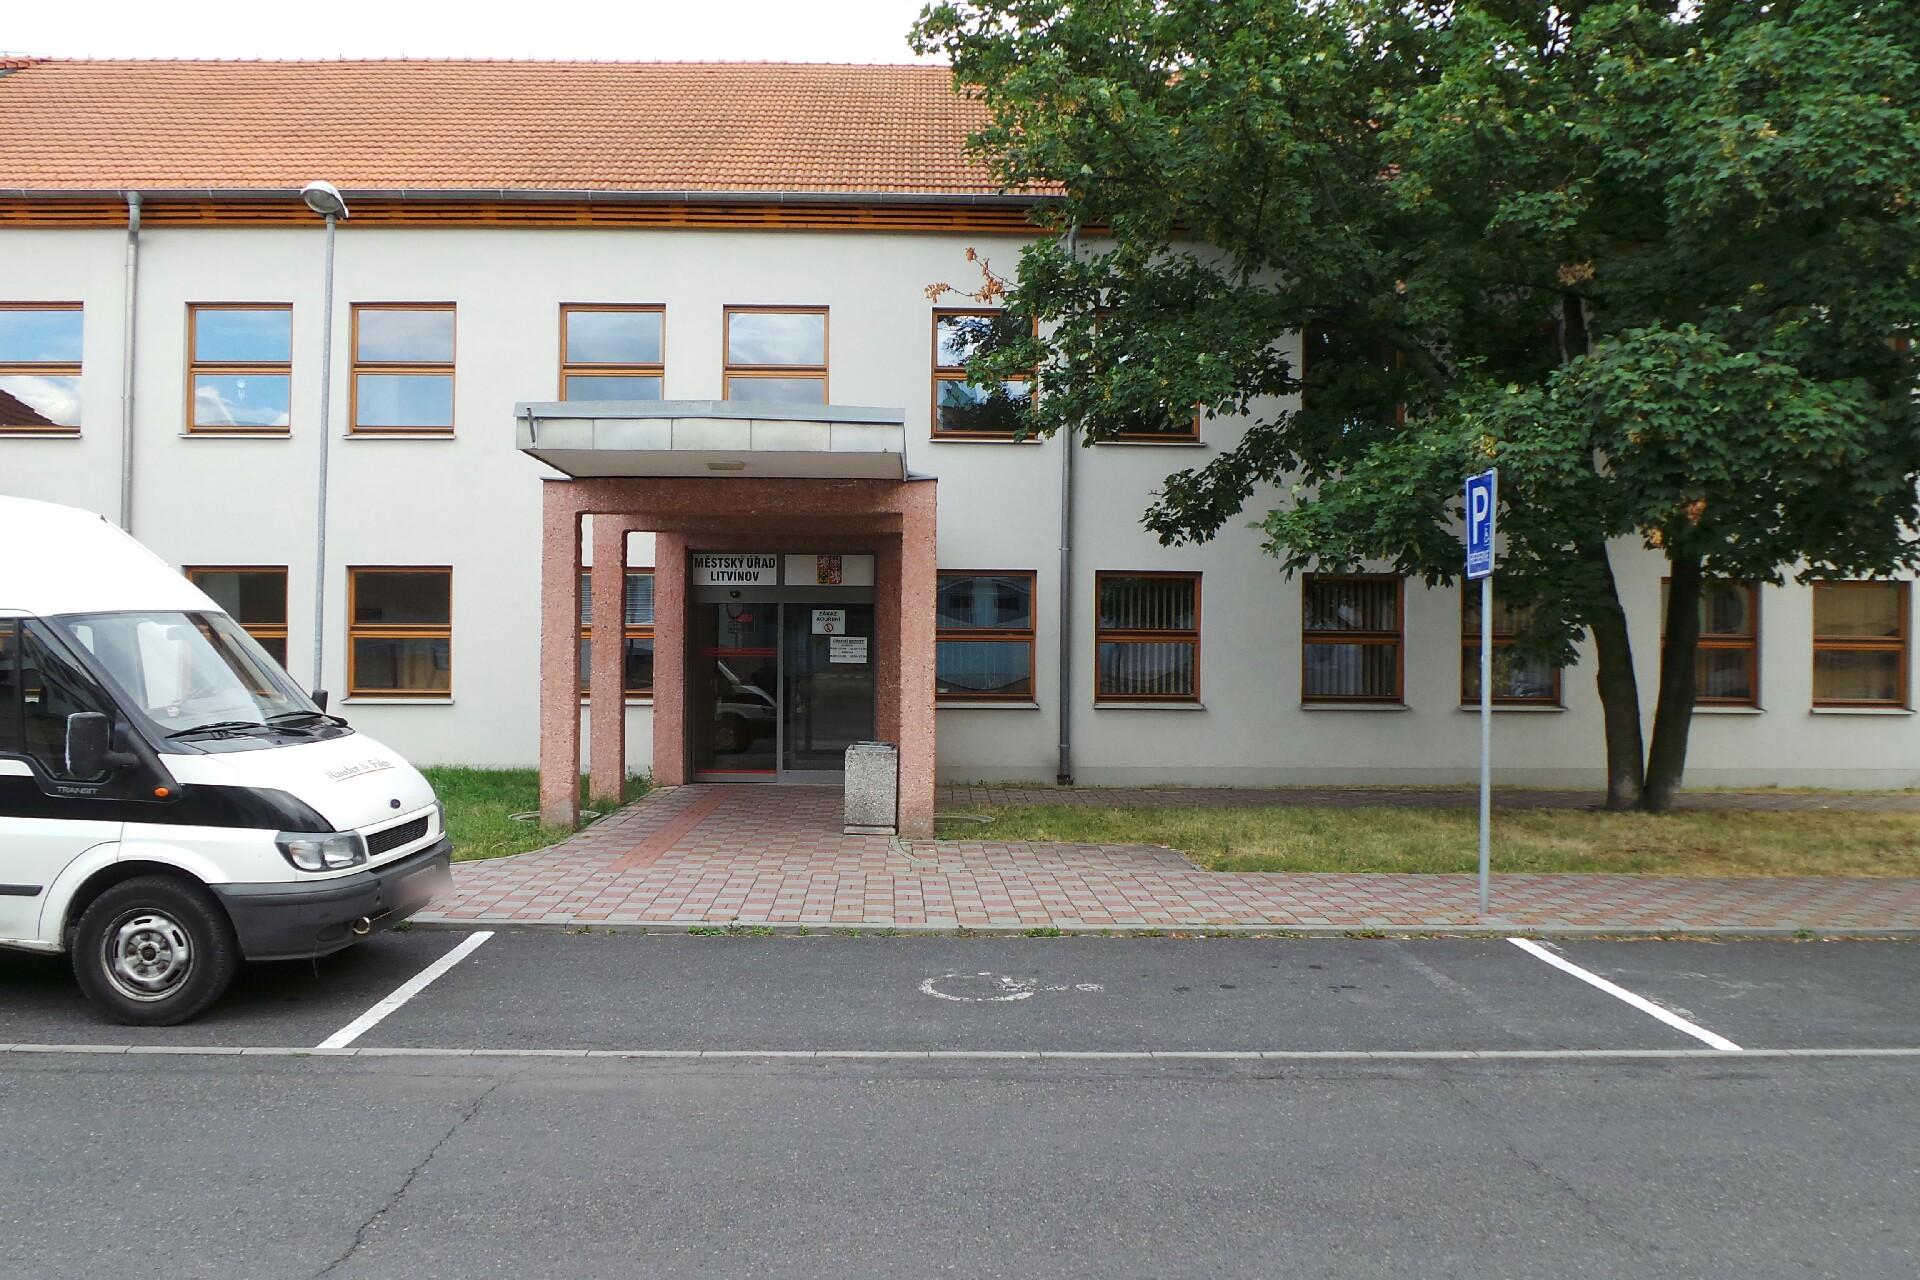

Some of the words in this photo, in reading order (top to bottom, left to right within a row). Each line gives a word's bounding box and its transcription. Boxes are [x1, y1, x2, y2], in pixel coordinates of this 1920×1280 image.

[1472, 486, 1489, 545] P
[694, 555, 745, 568] MĚSTSKÝ
[746, 555, 776, 568] ÚŘAD
[710, 569, 760, 582] LITVÍNOV
[56, 786, 98, 795] TRANSIT
